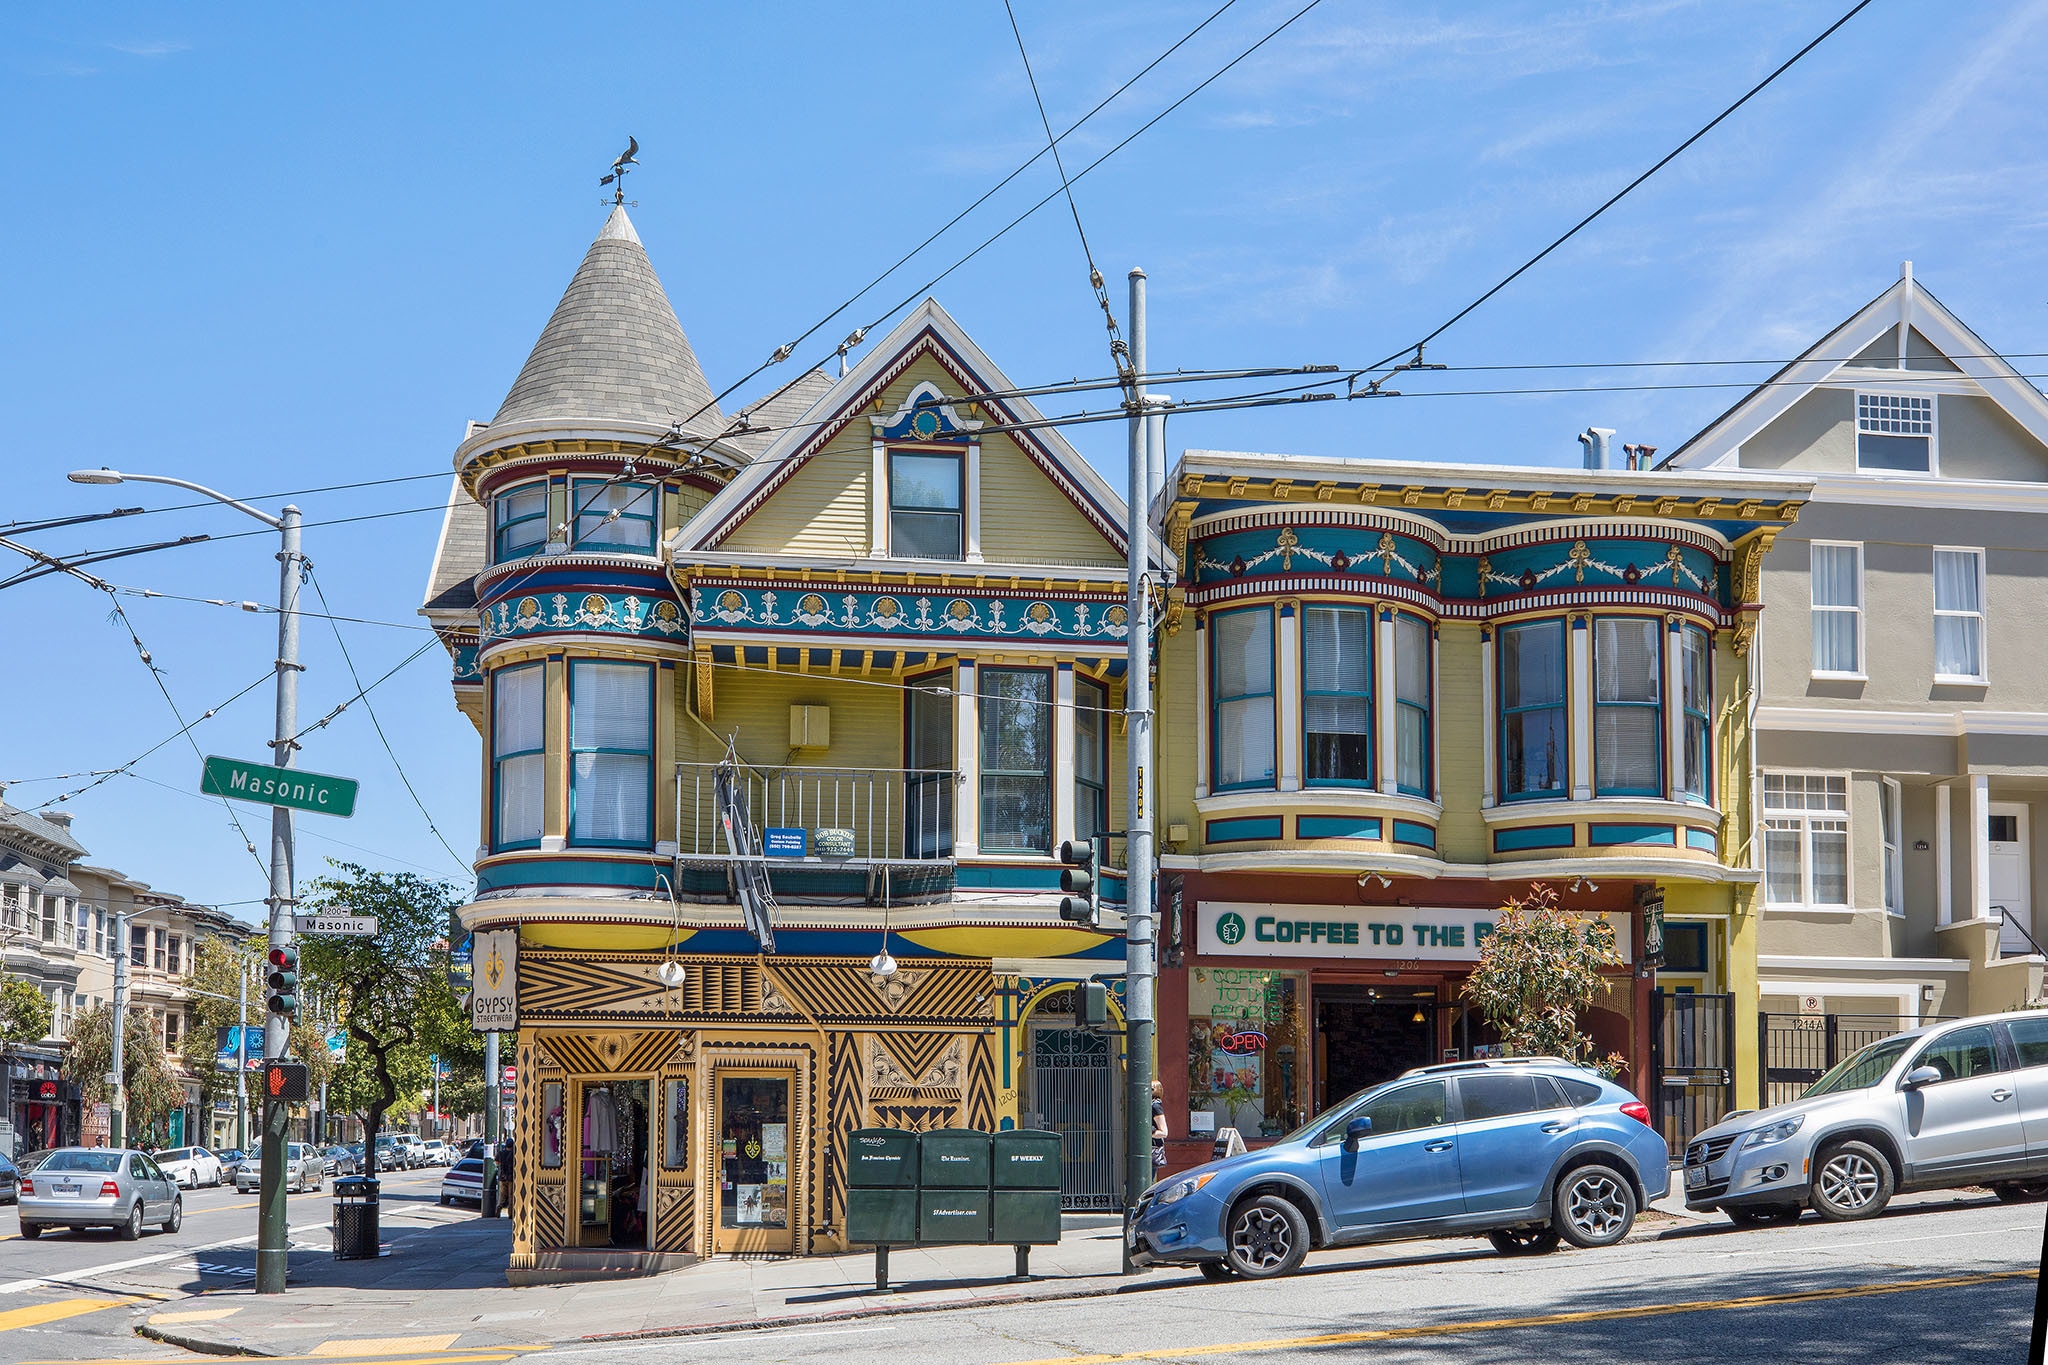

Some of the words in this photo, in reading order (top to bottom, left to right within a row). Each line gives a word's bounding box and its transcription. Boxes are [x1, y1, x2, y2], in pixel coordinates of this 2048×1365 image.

[230, 769, 329, 804] Masonic
[815, 830, 829, 840] BOB
[324, 907, 342, 915] 1200
[306, 919, 364, 931] Masonic
[1255, 916, 1359, 945] COFFEE
[1368, 923, 1404, 946] TO
[1412, 925, 1465, 947] THE
[450, 963, 473, 973] twili
[1396, 960, 1419, 970] 1206
[1213, 969, 1281, 985] COFFEE
[1216, 987, 1240, 1002] TO
[1246, 987, 1279, 1003] THE
[475, 996, 514, 1014] GYPSY
[1211, 1004, 1281, 1021] PEOPLE
[476, 1013, 513, 1023] STREETWEAR
[1791, 1019, 1824, 1031] 1214A
[1221, 1034, 1266, 1050] OPEN
[998, 1089, 1017, 1107] 1200
